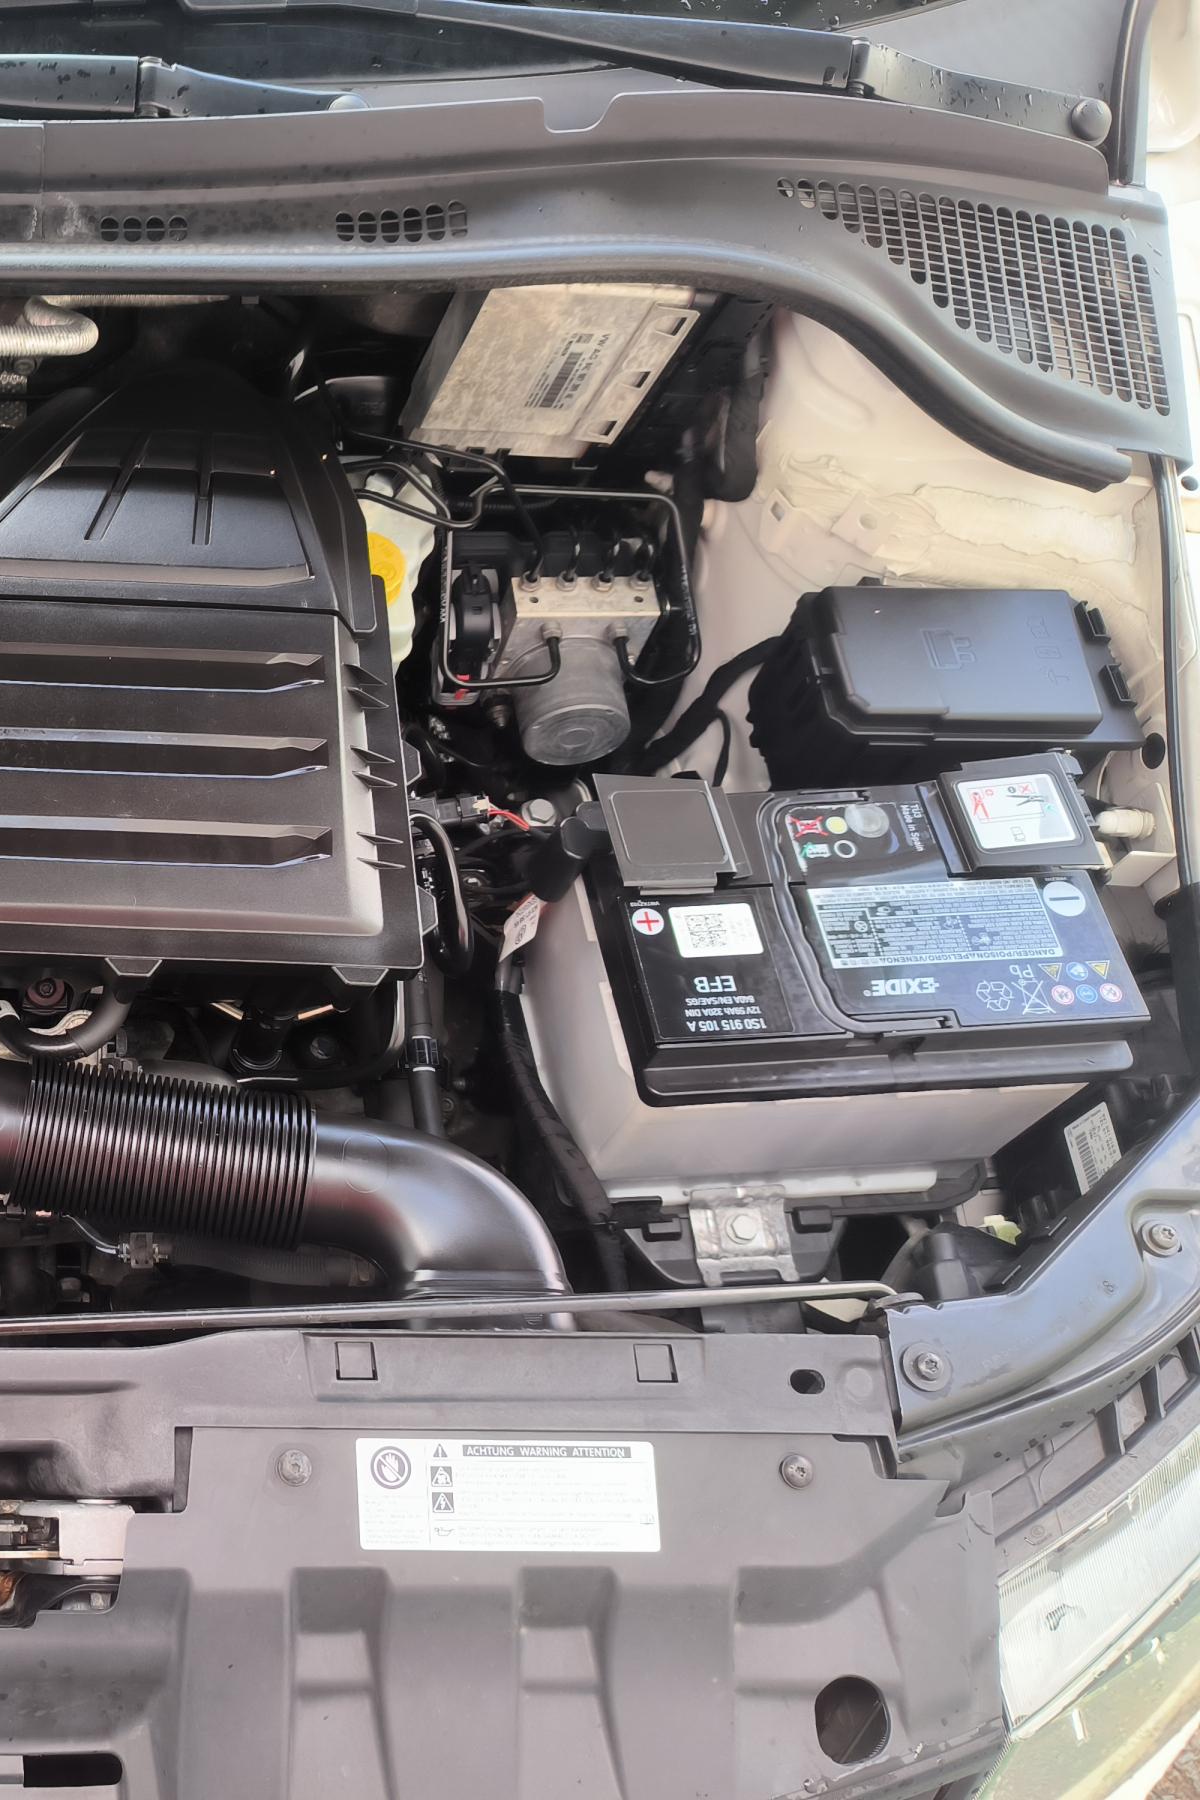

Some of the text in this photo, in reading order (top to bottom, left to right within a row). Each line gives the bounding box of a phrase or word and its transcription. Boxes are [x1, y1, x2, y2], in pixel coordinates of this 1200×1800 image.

[900, 804, 914, 823] Made
[910, 832, 924, 852] Spain
[1009, 964, 1035, 979] Pb
[693, 975, 737, 993] EFB
[685, 1008, 702, 1017] DIN
[702, 1007, 723, 1017] 320A
[746, 1006, 761, 1015] 12V
[686, 1021, 696, 1032] A
[699, 1020, 720, 1032] 105
[721, 1019, 743, 1030] 915
[466, 1446, 625, 1458] ACHTUNG WARNING ATTENTION
